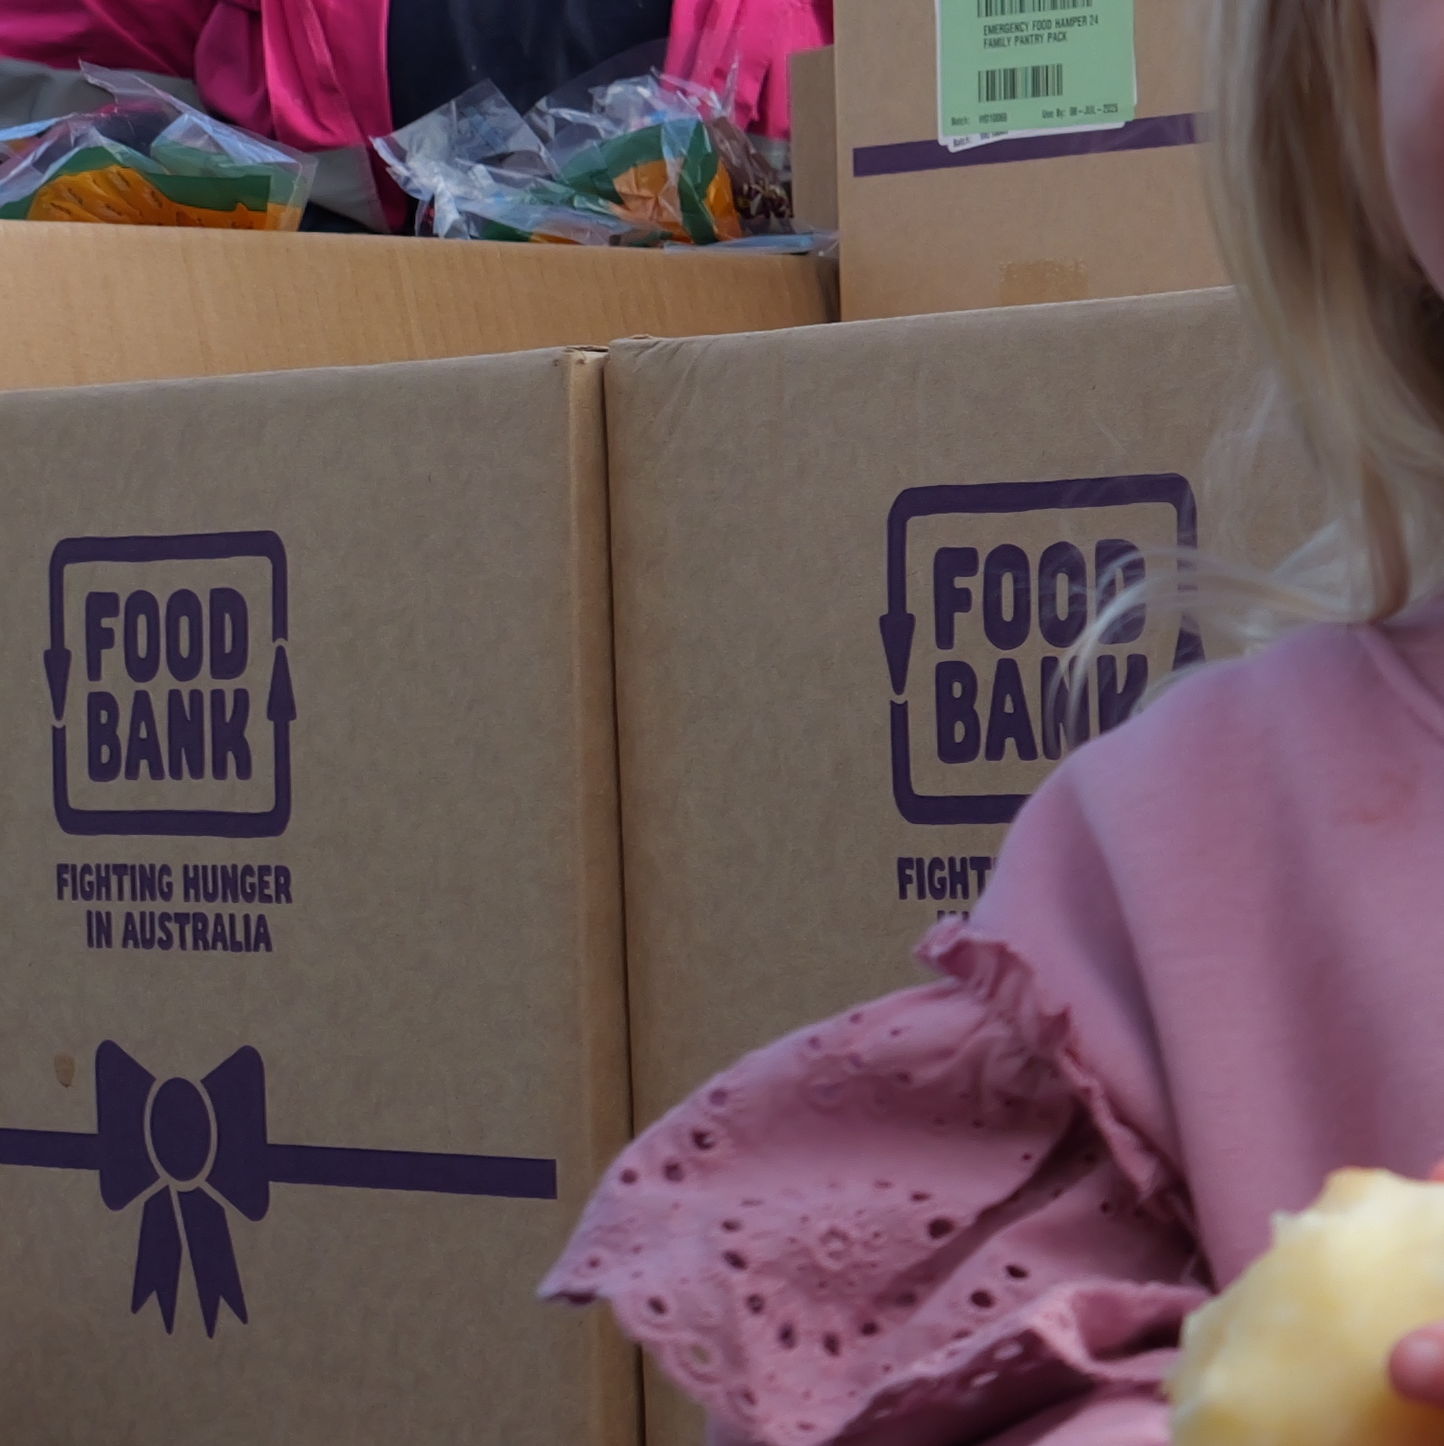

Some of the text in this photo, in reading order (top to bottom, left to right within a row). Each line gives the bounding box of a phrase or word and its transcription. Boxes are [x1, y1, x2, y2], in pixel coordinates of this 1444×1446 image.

[84, 588, 250, 683] FOOD
[933, 538, 1148, 651] FOOD
[86, 687, 253, 783] BANK
[56, 863, 293, 905] FIGHTING HUNGER
[85, 910, 274, 953] IN AUSTRALIA
